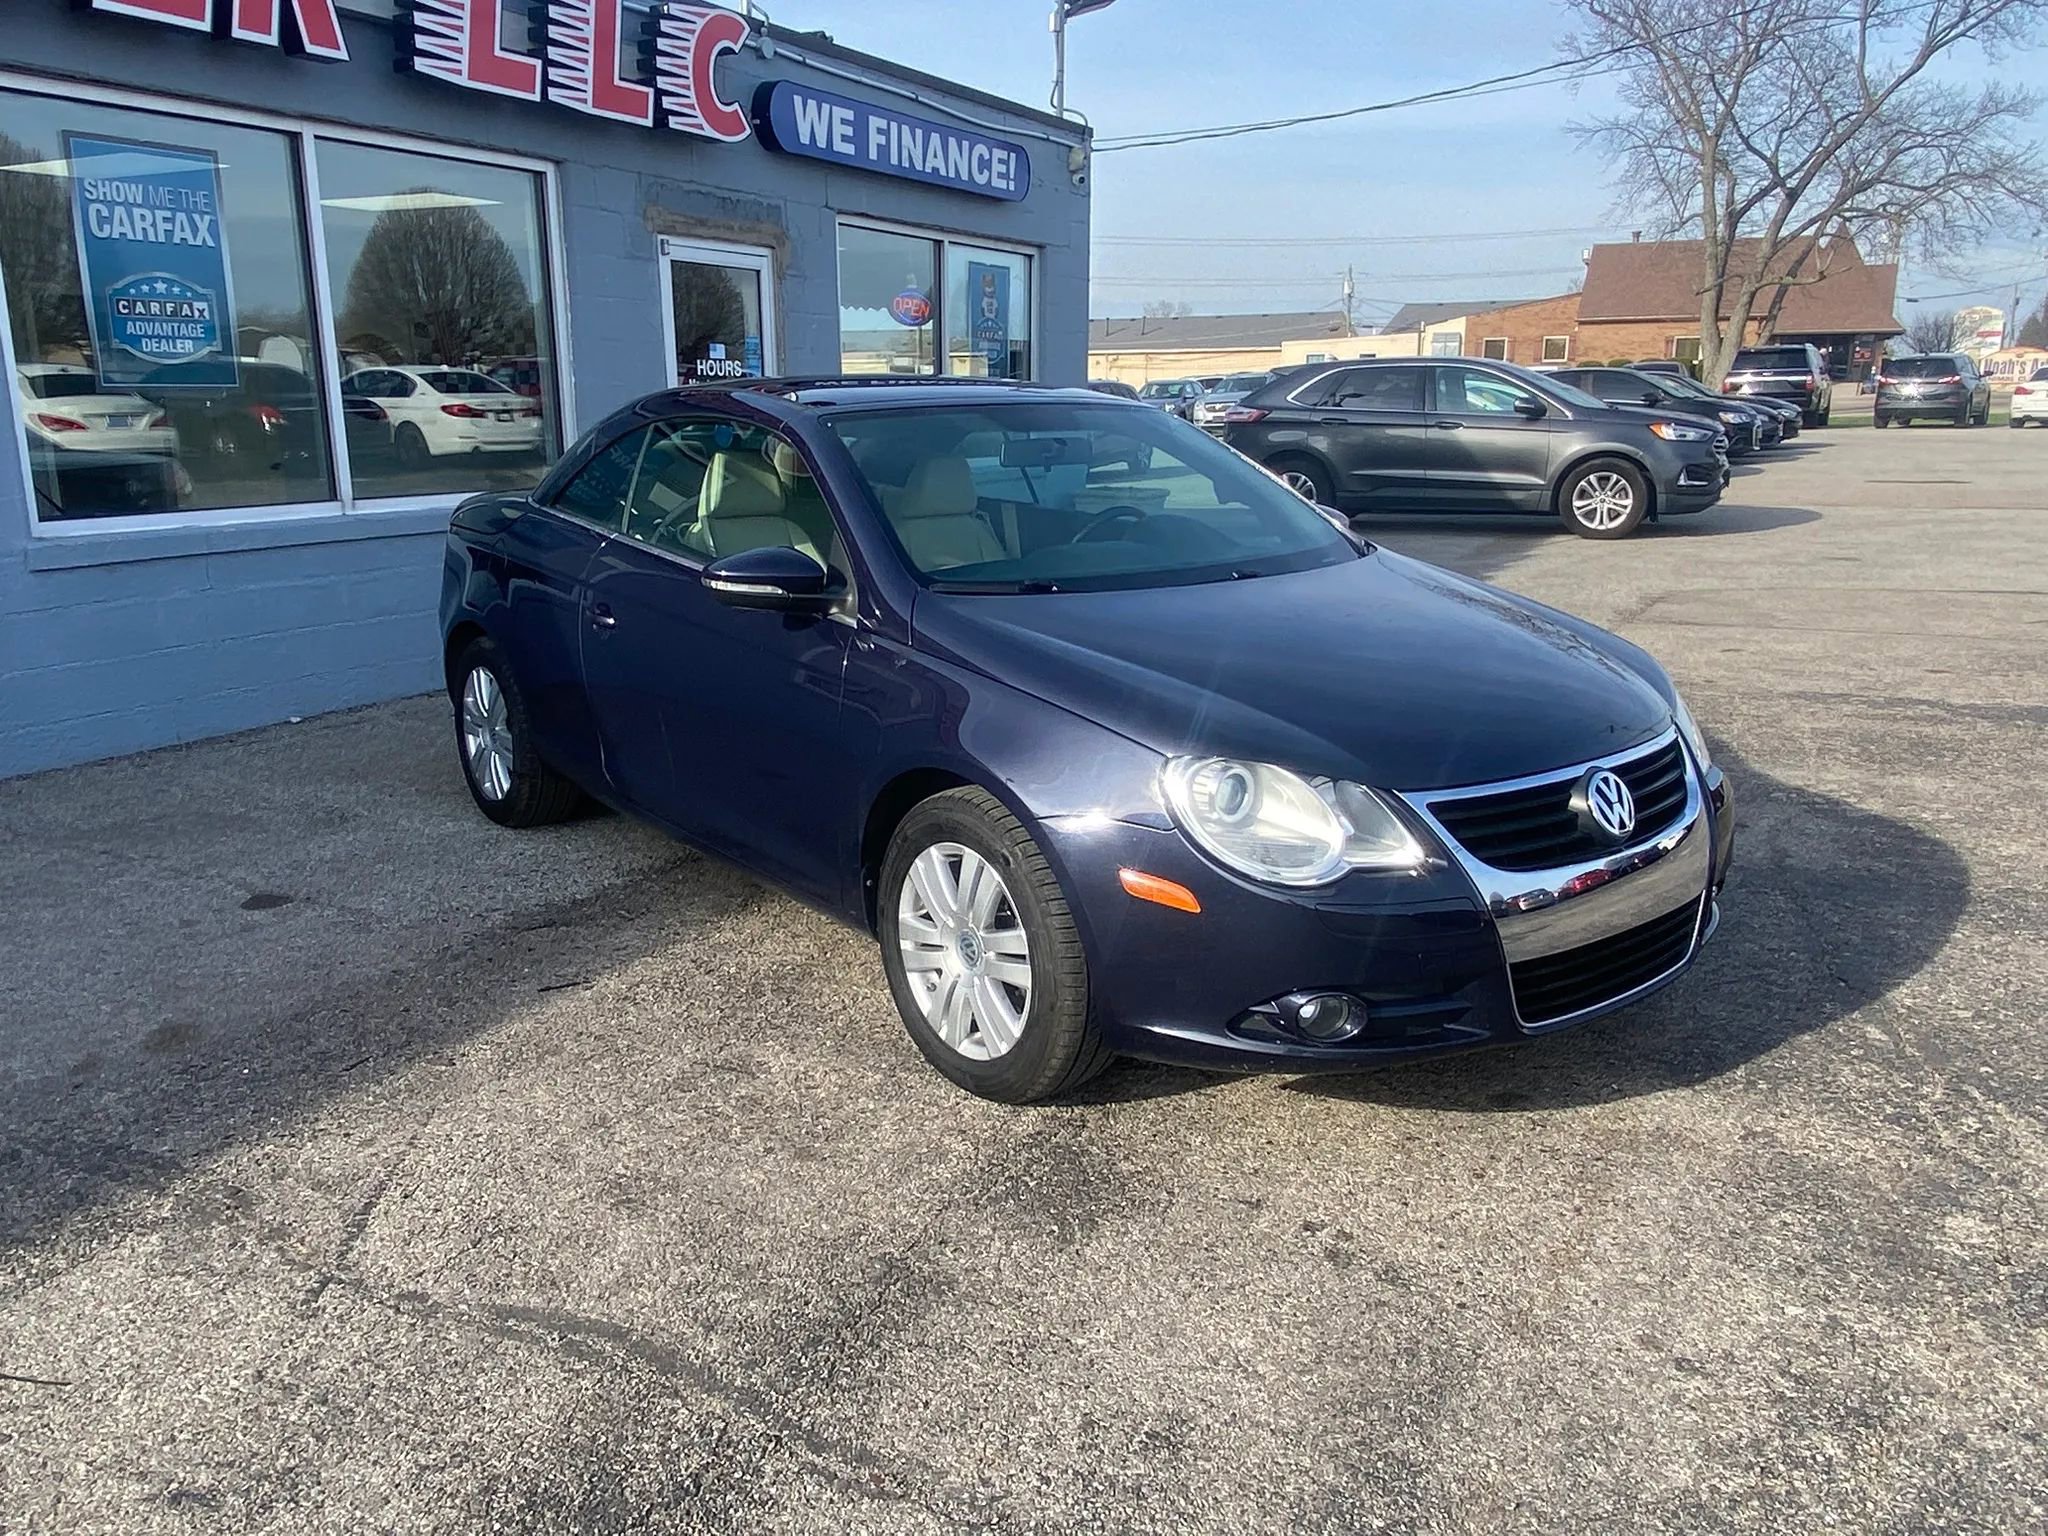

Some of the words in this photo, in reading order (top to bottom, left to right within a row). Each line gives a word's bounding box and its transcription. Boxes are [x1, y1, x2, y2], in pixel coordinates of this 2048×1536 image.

[792, 94, 856, 156] WE
[867, 114, 1017, 192] FINANCE!
[83, 177, 144, 206] SHOW
[148, 184, 174, 210] ME
[177, 187, 211, 213] THE
[87, 203, 216, 248] CARFAX
[117, 299, 209, 320] CARFAX
[892, 297, 931, 318] OPEN
[125, 320, 206, 338] ADVANTAGE
[141, 338, 195, 354] DEALER
[696, 358, 743, 377] HOURS
[1587, 769, 1635, 837] VW
